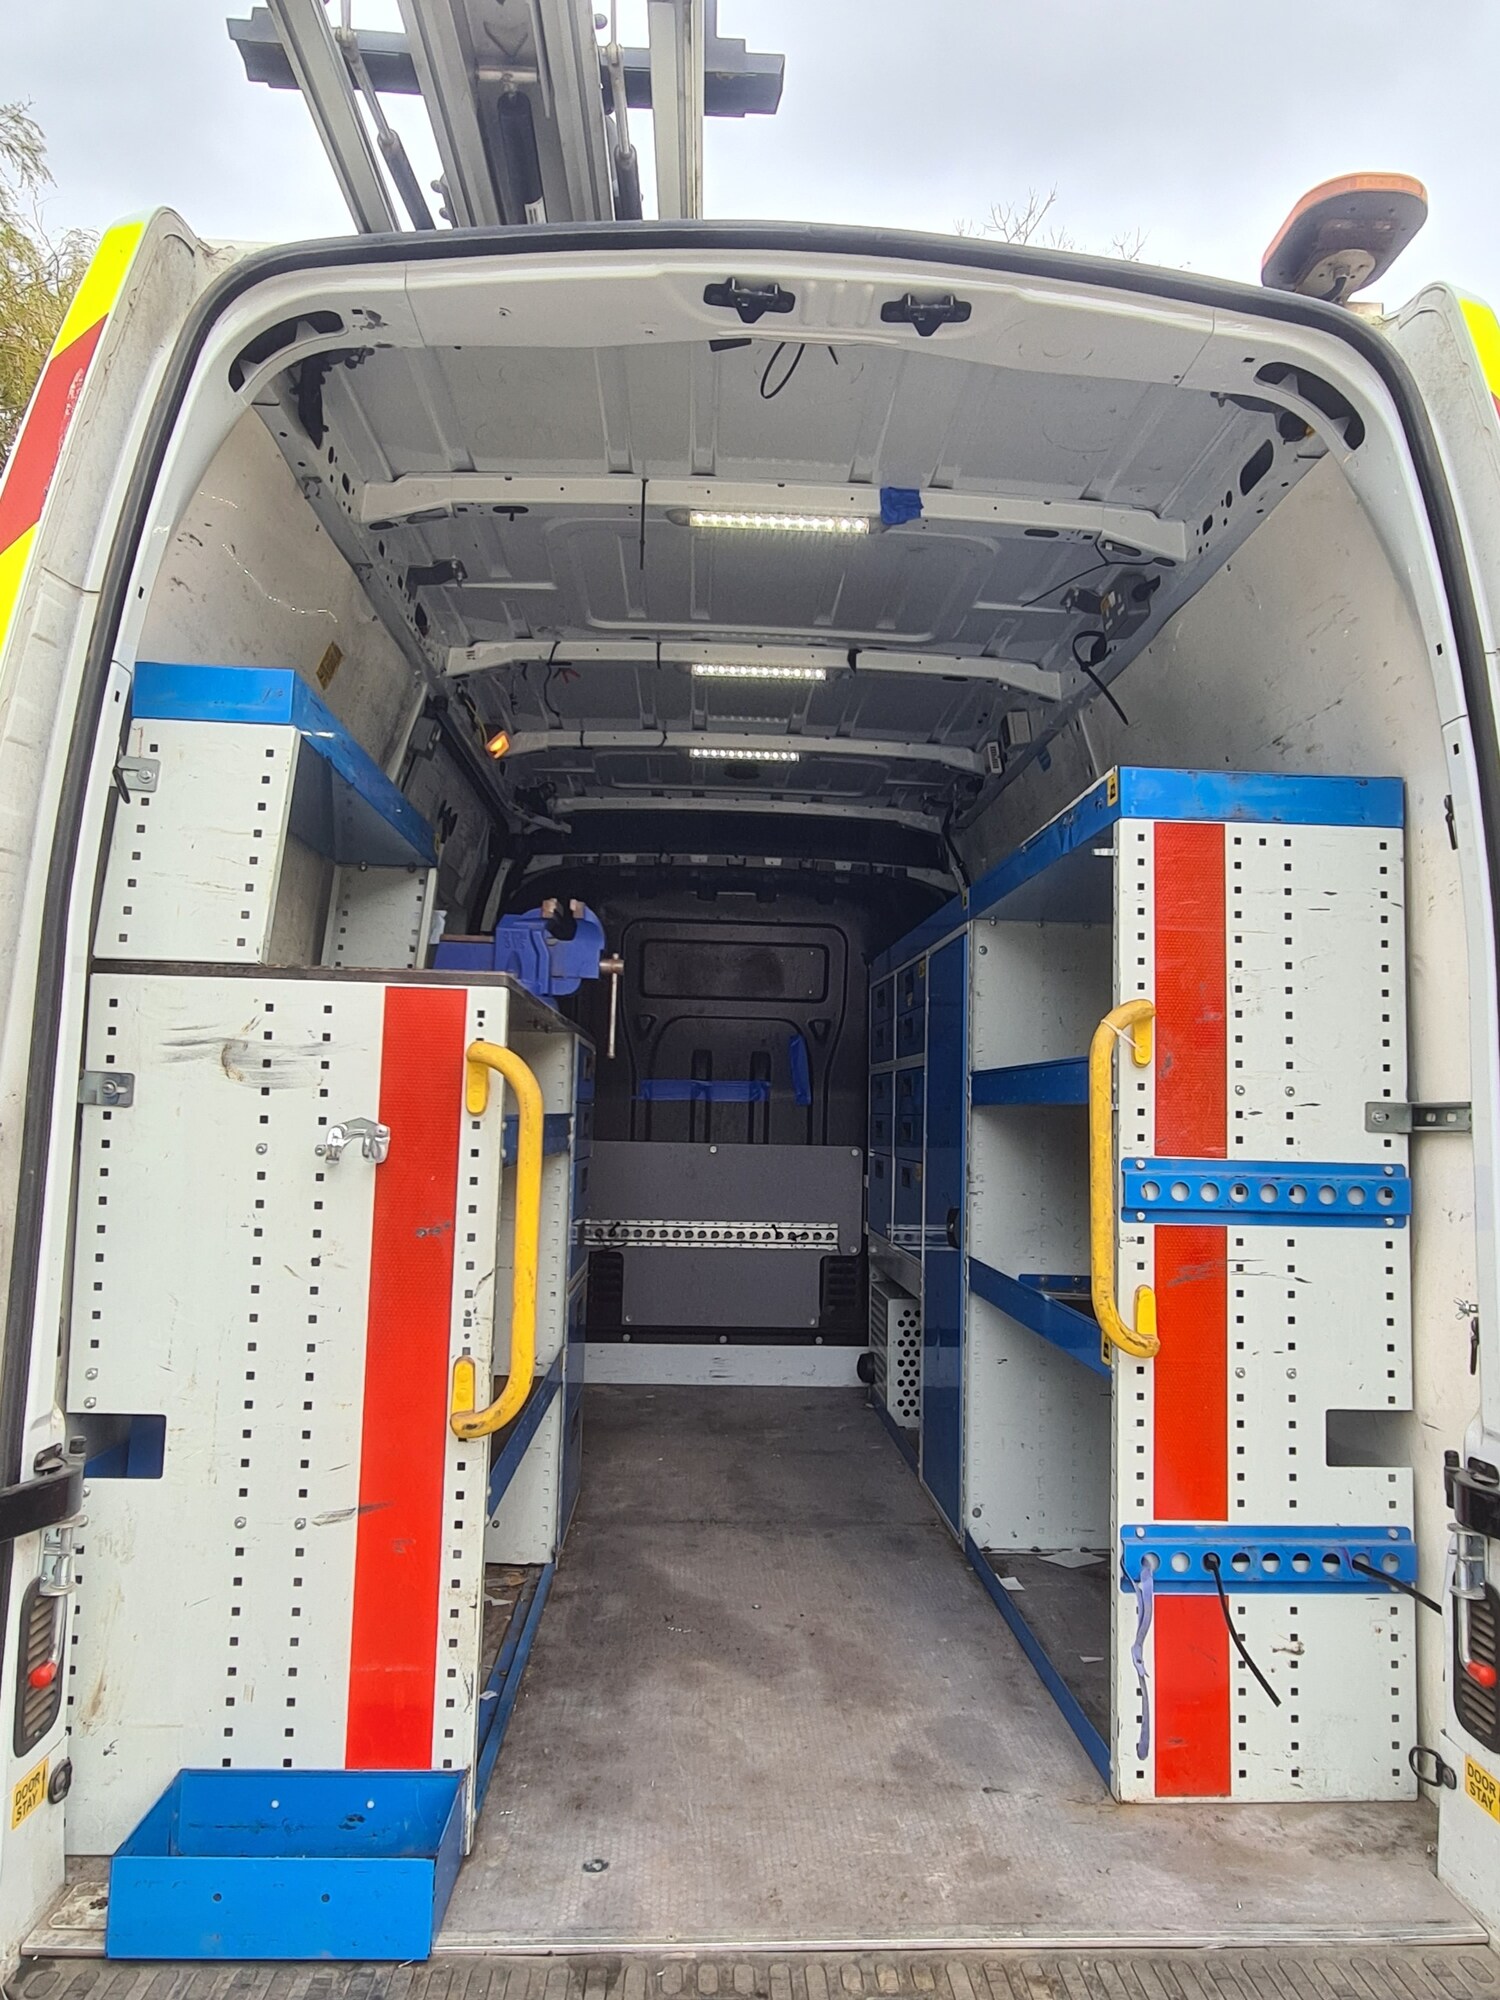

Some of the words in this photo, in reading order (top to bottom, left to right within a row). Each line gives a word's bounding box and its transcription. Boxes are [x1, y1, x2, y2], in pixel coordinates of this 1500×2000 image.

[16, 1771, 40, 1806] DOOR
[1467, 1762, 1496, 1798] DOOR
[1469, 1781, 1494, 1811] STAY
[16, 1789, 38, 1821] STAY
